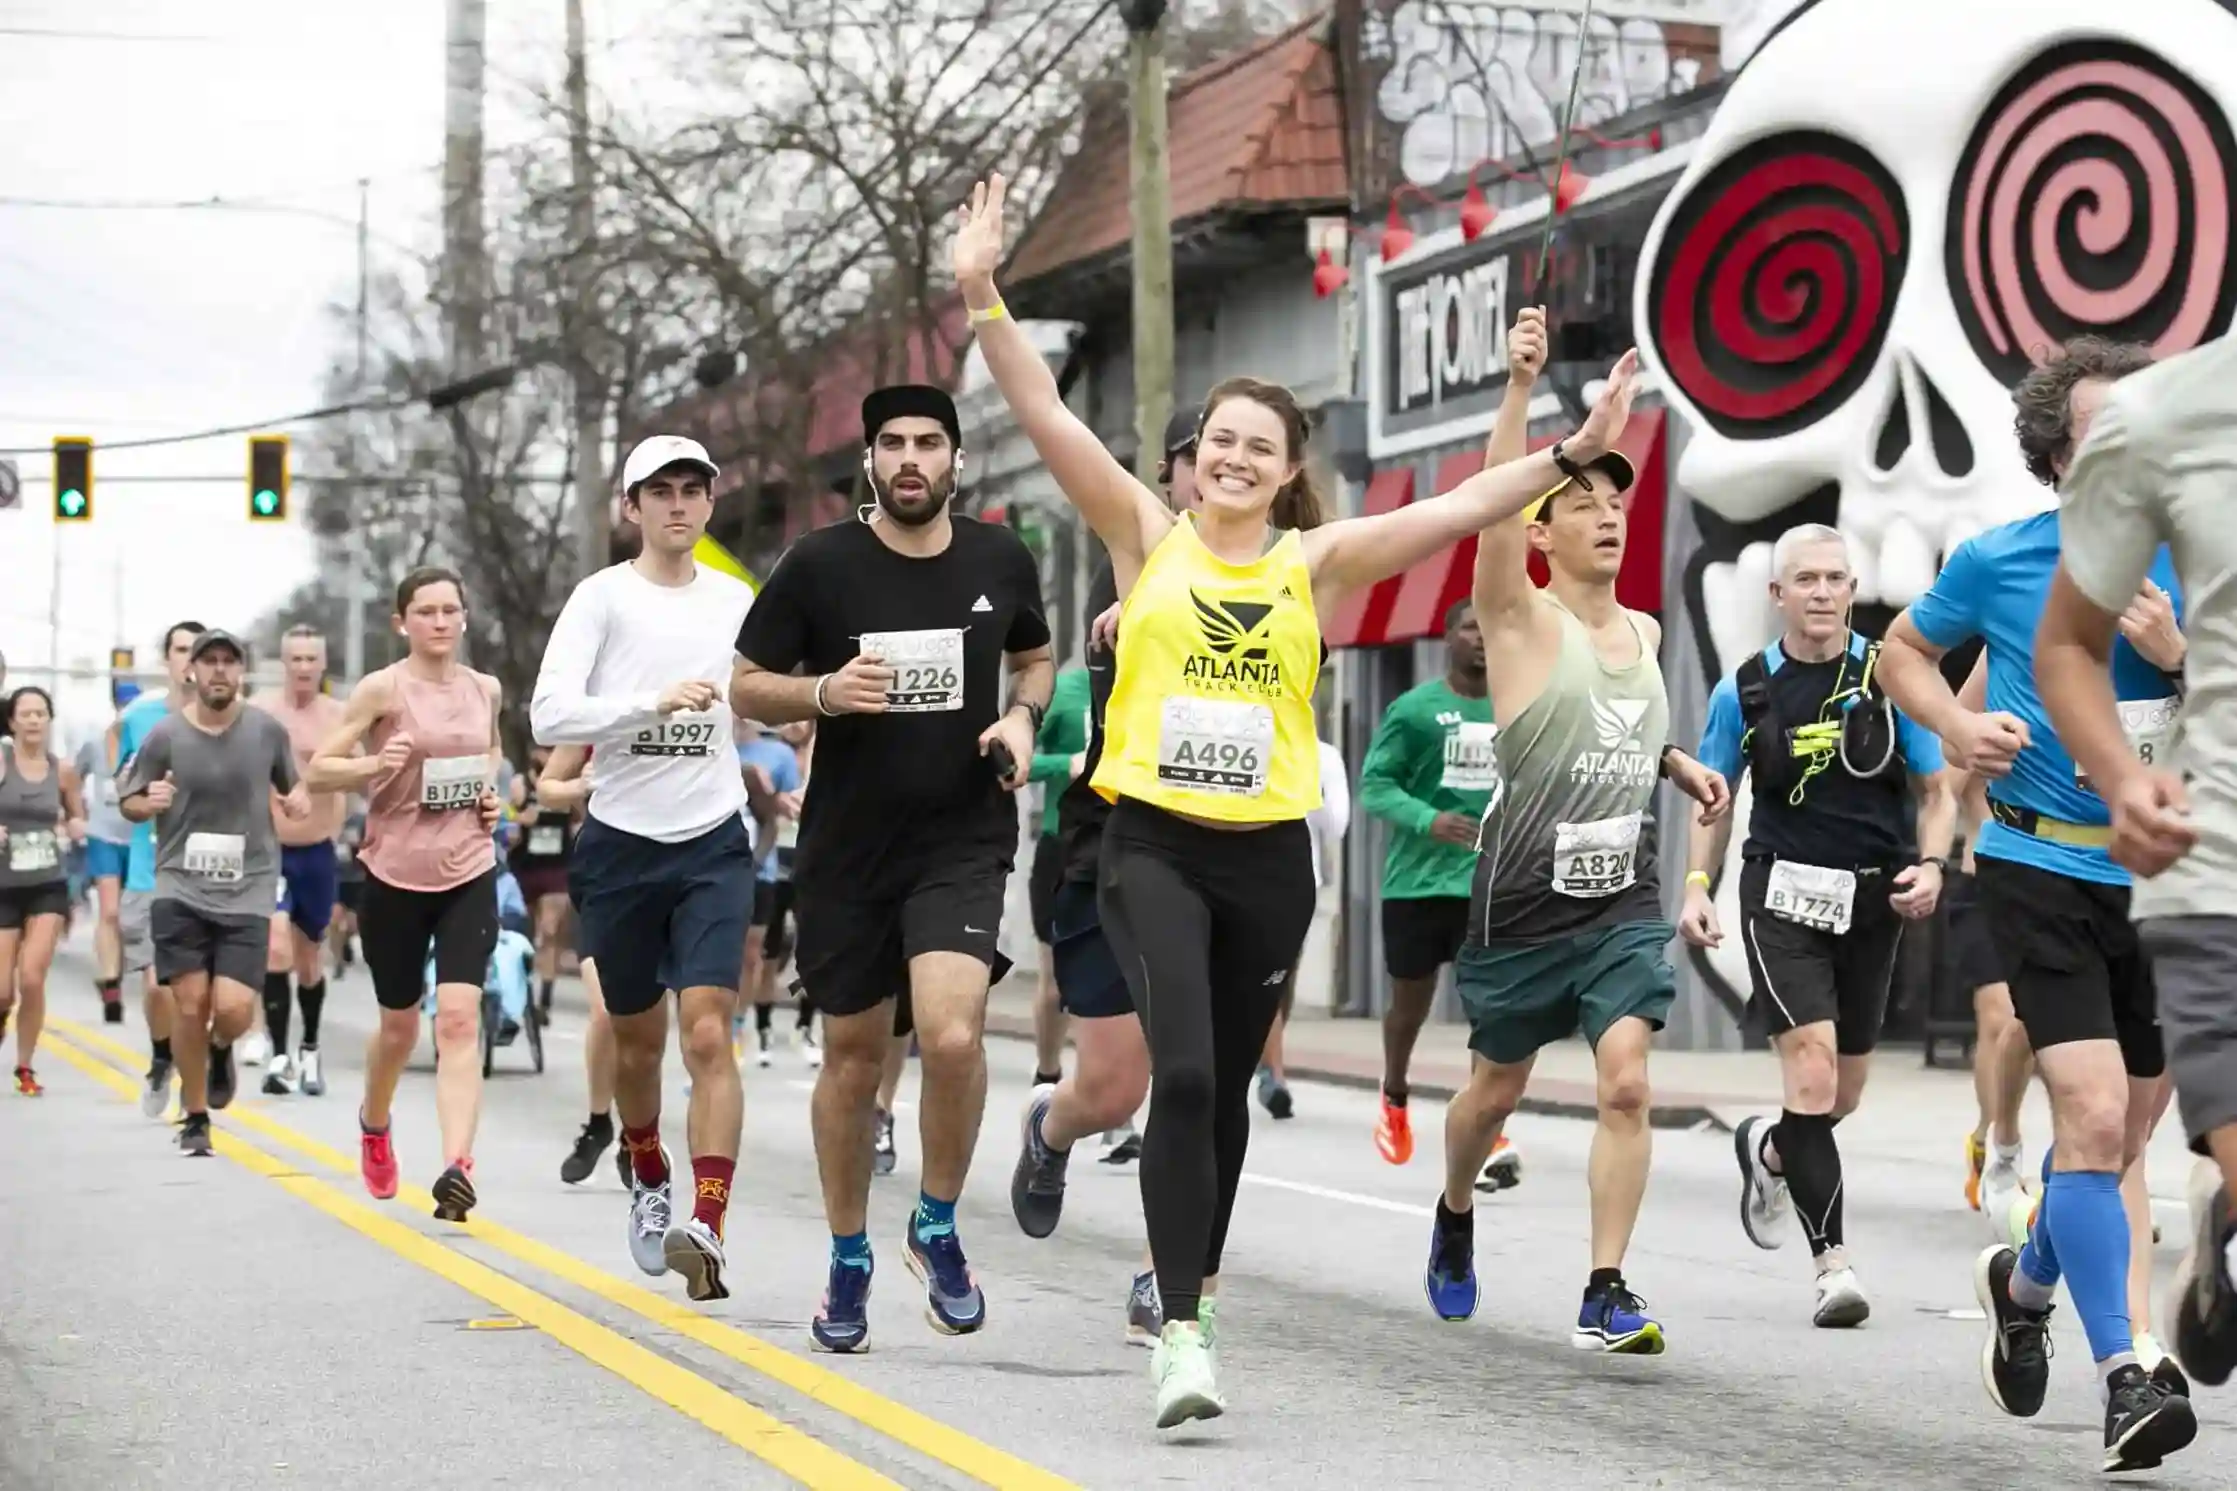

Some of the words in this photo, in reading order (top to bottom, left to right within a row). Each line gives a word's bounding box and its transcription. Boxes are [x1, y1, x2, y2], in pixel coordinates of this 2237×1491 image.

[889, 667, 958, 691] 1226
[1183, 654, 1280, 685] ATLANTA
[1184, 678, 1238, 692] TRACK
[1173, 740, 1258, 771] A496
[1570, 751, 1655, 776] ATLANTA
[427, 780, 484, 801] B1739
[1568, 851, 1630, 877] A820
[1772, 889, 1845, 921] B1774
